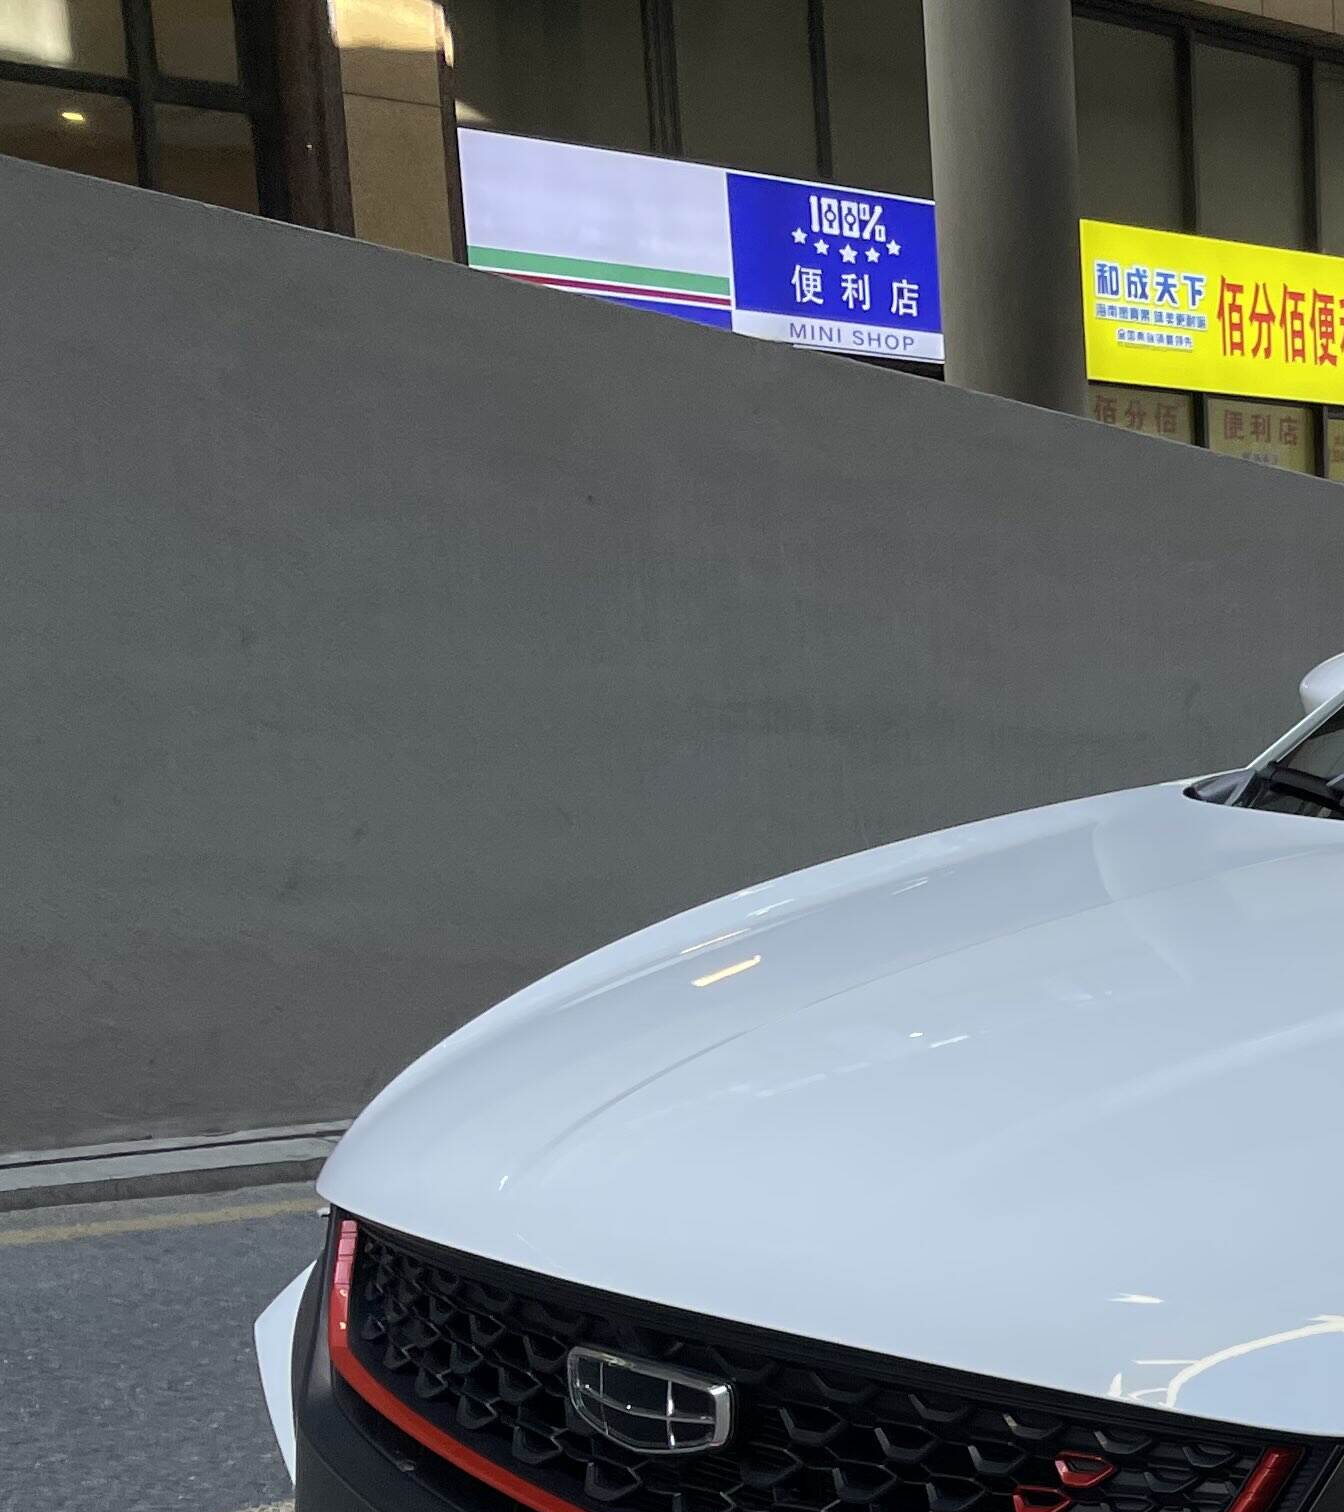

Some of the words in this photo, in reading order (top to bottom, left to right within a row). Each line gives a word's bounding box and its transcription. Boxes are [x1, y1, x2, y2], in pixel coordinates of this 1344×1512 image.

[809, 195, 886, 242] 100%
[791, 264, 919, 317] 便利店
[1095, 262, 1205, 307] 和成天下
[789, 322, 842, 343] MINI
[852, 330, 915, 351] SHOP
[1224, 409, 1300, 446] 便利店
